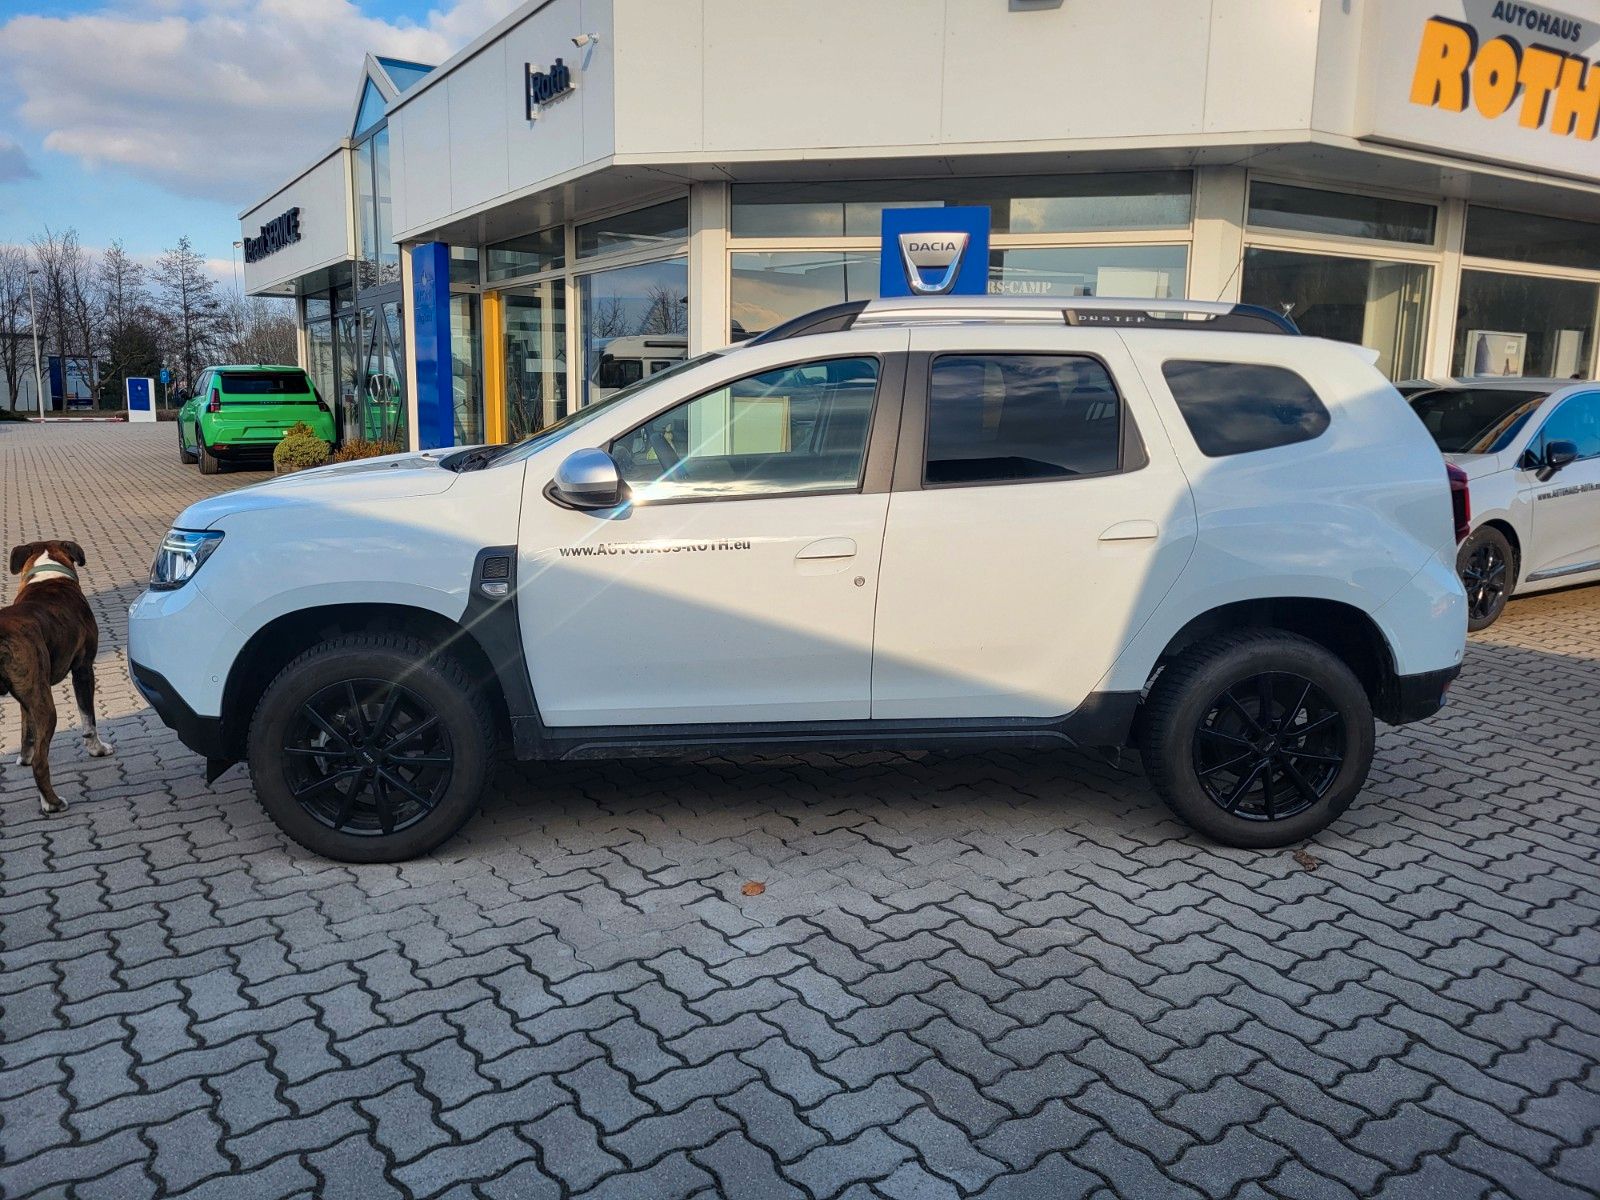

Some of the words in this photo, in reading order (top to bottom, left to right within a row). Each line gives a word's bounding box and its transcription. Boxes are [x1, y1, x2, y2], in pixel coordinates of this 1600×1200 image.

[1491, 1, 1582, 42] AUTOHAUS
[531, 58, 570, 104] Roth
[1409, 15, 1600, 141] ROTH
[909, 241, 956, 252] DACIA
[1078, 315, 1146, 323] DUSTER
